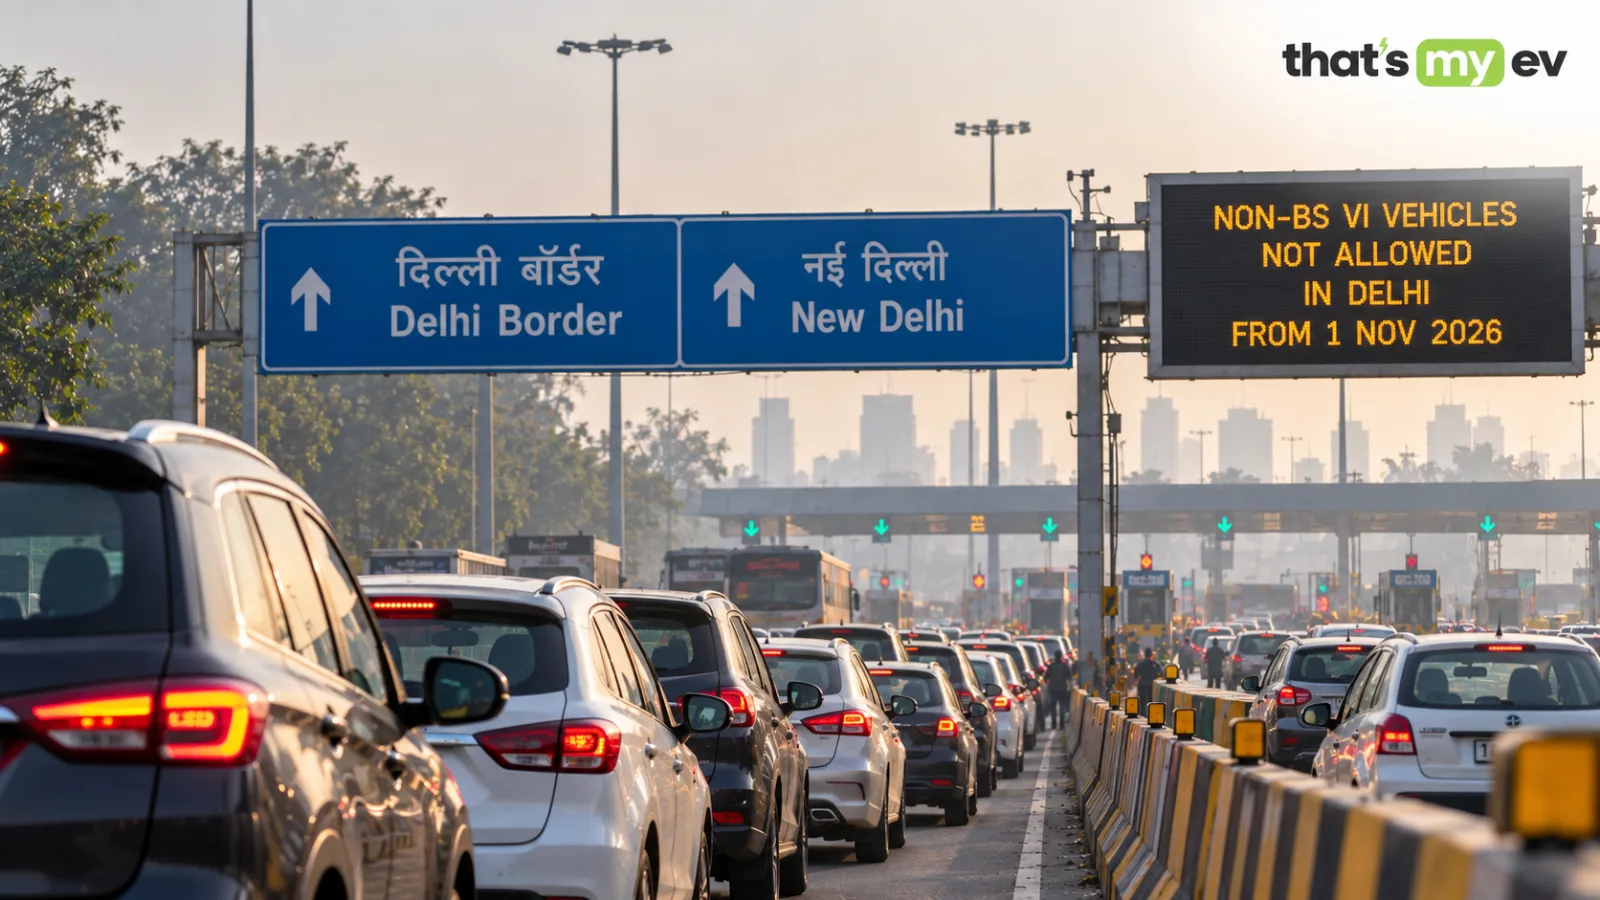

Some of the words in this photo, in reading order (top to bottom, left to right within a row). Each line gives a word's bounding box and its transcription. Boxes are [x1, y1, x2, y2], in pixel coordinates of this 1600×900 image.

[1214, 203, 1330, 230] NON-BS
[1342, 203, 1369, 229] VI
[1382, 201, 1517, 228] VEHICLES
[395, 245, 501, 289] दिल्ली
[518, 243, 605, 286] बॉर्डर
[801, 241, 847, 288] नई
[861, 240, 949, 284] दिल्ली
[1262, 242, 1321, 268] NOT
[1334, 240, 1472, 267] ALLOWED
[1304, 280, 1331, 306] IN
[1348, 279, 1430, 306] DELHI
[390, 303, 480, 337] Delhi
[499, 302, 623, 336] Border
[792, 301, 865, 333] New
[880, 298, 963, 332] Delhi
[1232, 320, 1311, 347] FROM
[1327, 320, 1341, 346] 1
[1356, 319, 1417, 346] NOV
[1431, 318, 1503, 345] 2026
